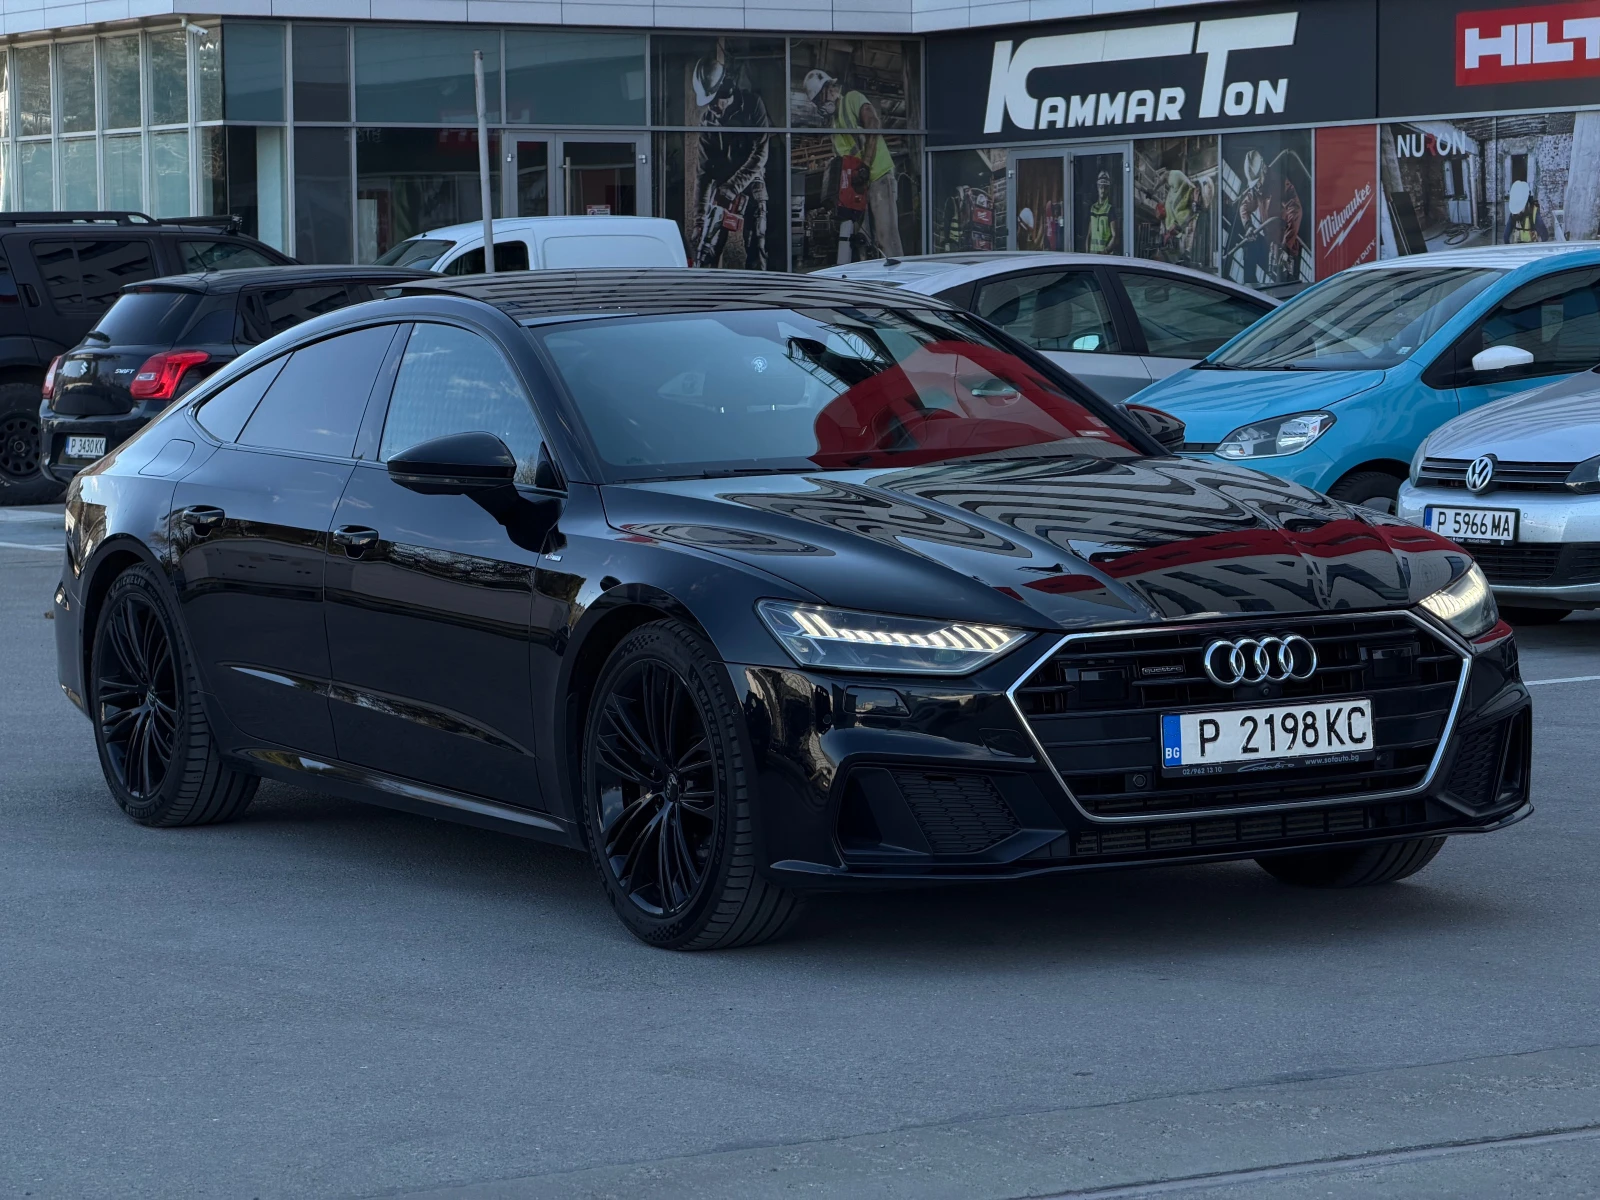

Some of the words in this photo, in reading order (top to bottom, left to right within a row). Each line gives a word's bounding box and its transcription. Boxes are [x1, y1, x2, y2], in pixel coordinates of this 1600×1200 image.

[1397, 131, 1466, 158] NURON
[1316, 183, 1372, 247] Milwaukee
[71, 438, 76, 453] P
[1437, 511, 1446, 533] P
[1453, 511, 1488, 535] 5966
[1491, 513, 1510, 537] MA
[698, 689, 727, 782] MICHELIN
[1199, 718, 1220, 757] P
[1165, 747, 1180, 759] BG
[1304, 753, 1360, 765] www.sofauto.bg
